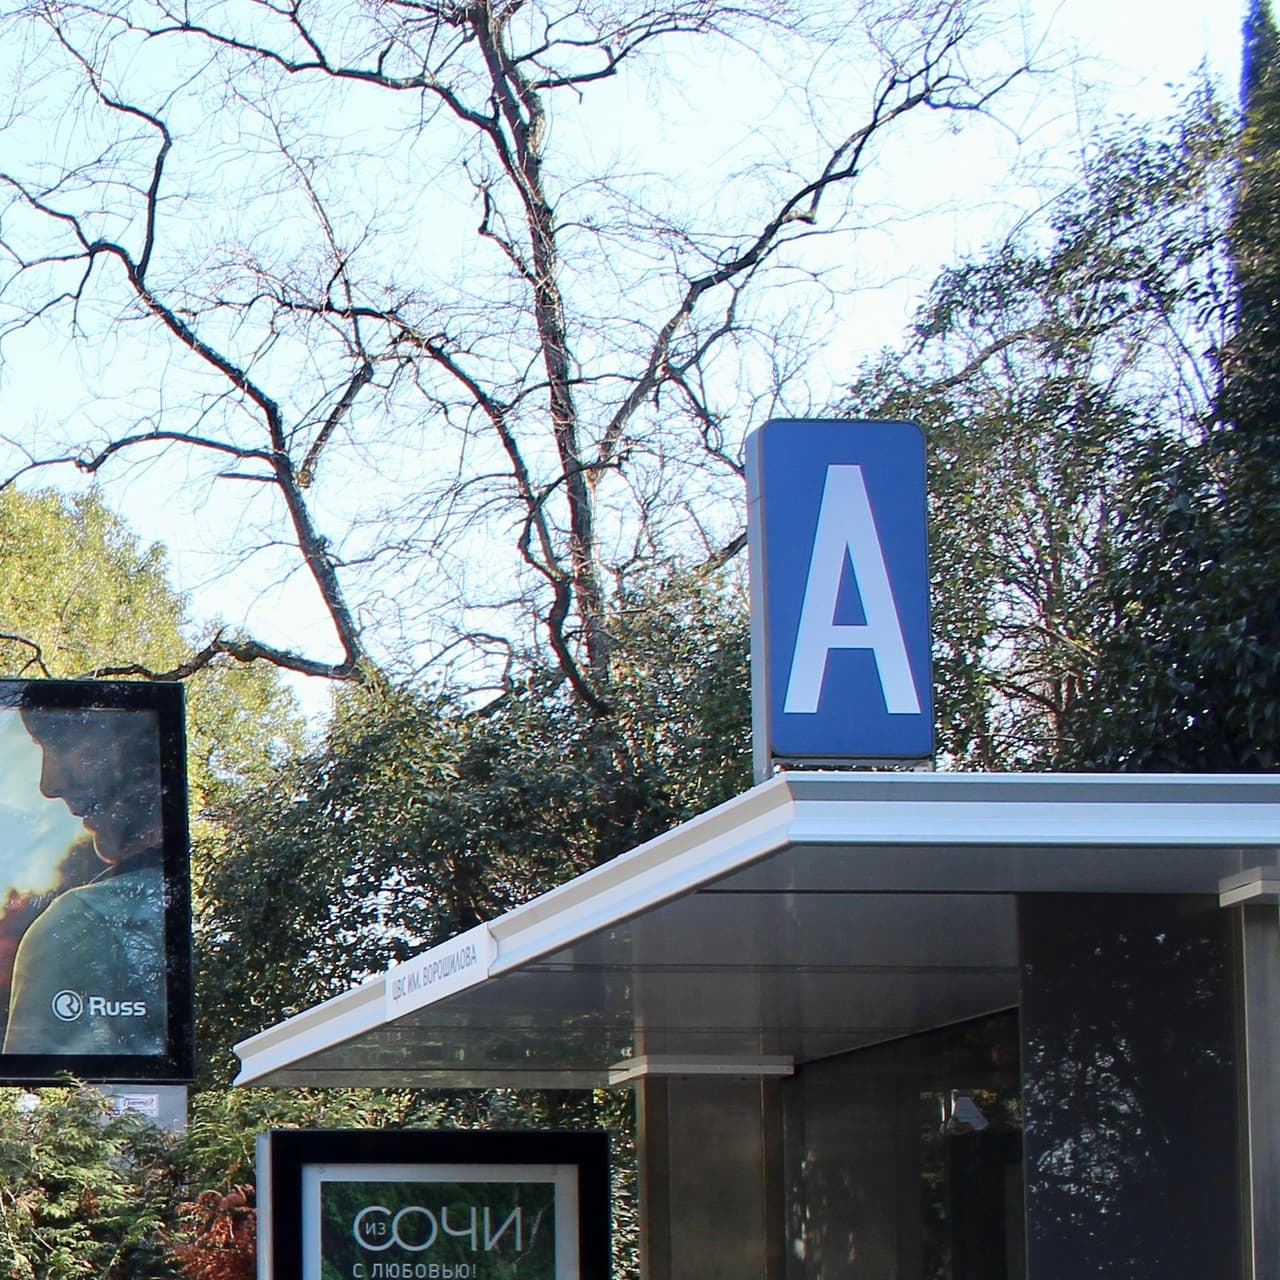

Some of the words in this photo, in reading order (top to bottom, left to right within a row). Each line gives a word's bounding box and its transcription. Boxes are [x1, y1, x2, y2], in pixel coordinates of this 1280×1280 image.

[423, 944, 477, 986] ВОРОШИЛОВА
[88, 996, 147, 1017] Russ
[353, 1205, 522, 1251] СОЧИ
[371, 1263, 477, 1279] ЛЮБОВЬЮ!
